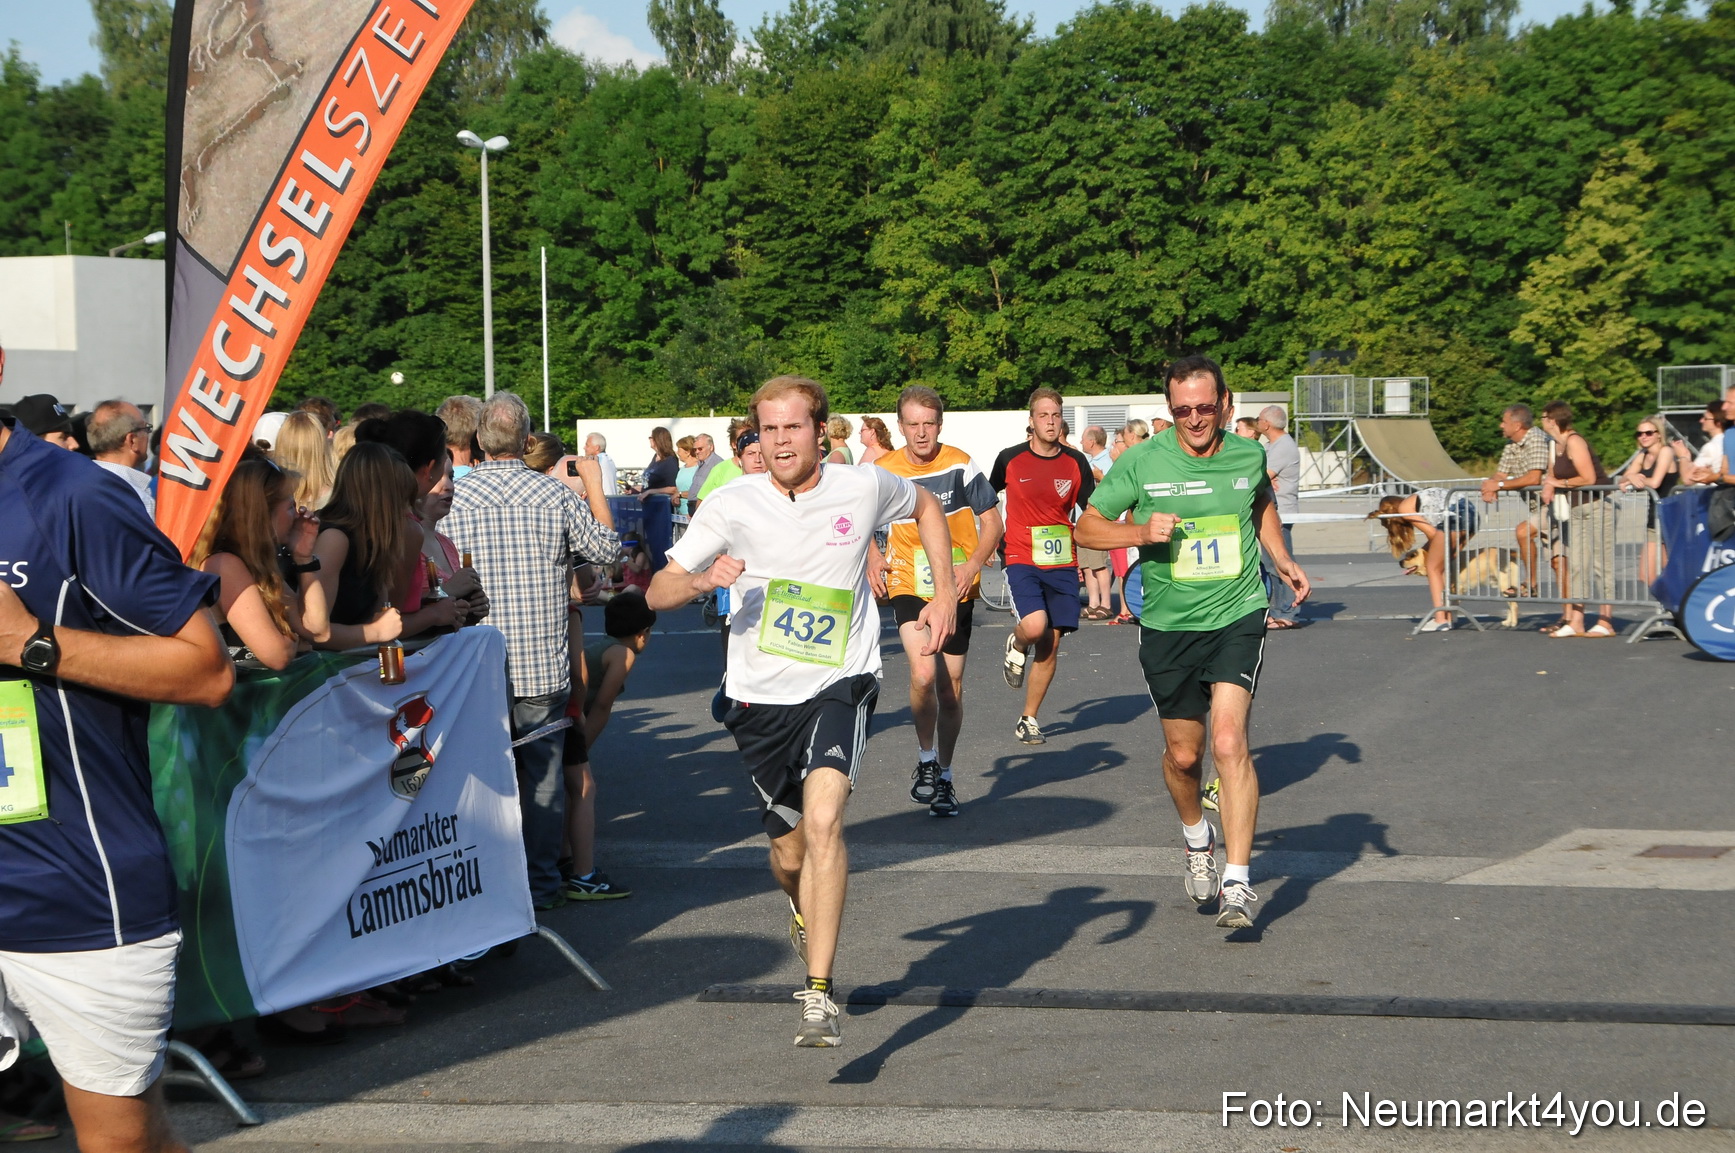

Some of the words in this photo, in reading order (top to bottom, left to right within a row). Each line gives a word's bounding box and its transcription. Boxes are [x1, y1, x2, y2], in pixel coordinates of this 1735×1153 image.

[160, 0, 440, 489] WECHSELSZE
[1044, 539, 1062, 555] 90
[1190, 539, 1219, 565] 11
[773, 607, 836, 645] 432
[347, 849, 483, 939] Lammsbräu
